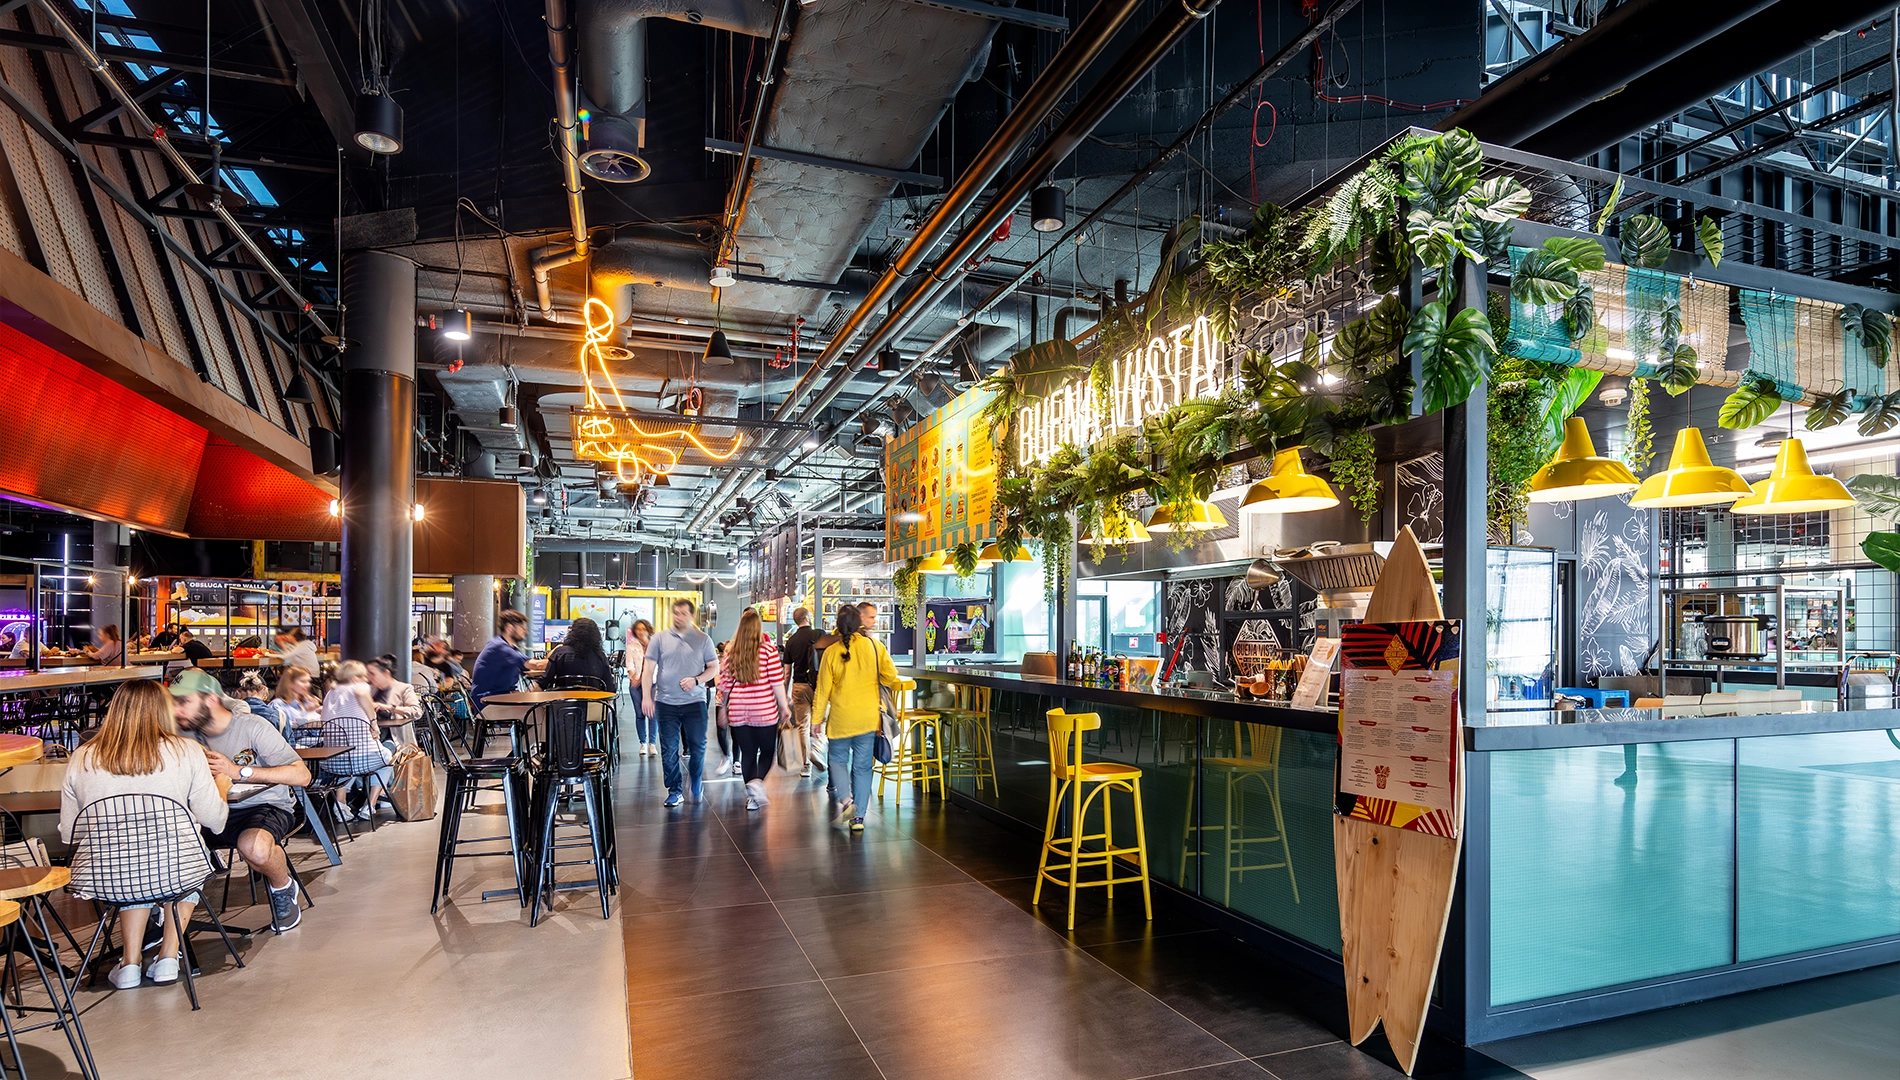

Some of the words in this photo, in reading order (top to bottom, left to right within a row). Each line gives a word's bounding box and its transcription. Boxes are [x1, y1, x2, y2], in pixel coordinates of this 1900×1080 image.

[1250, 266, 1344, 331] SOCIAL
[1259, 308, 1330, 355] FOOD
[1019, 375, 1103, 467] BUENA
[1112, 315, 1222, 428] VISTA
[1236, 643, 1258, 657] BUENA
